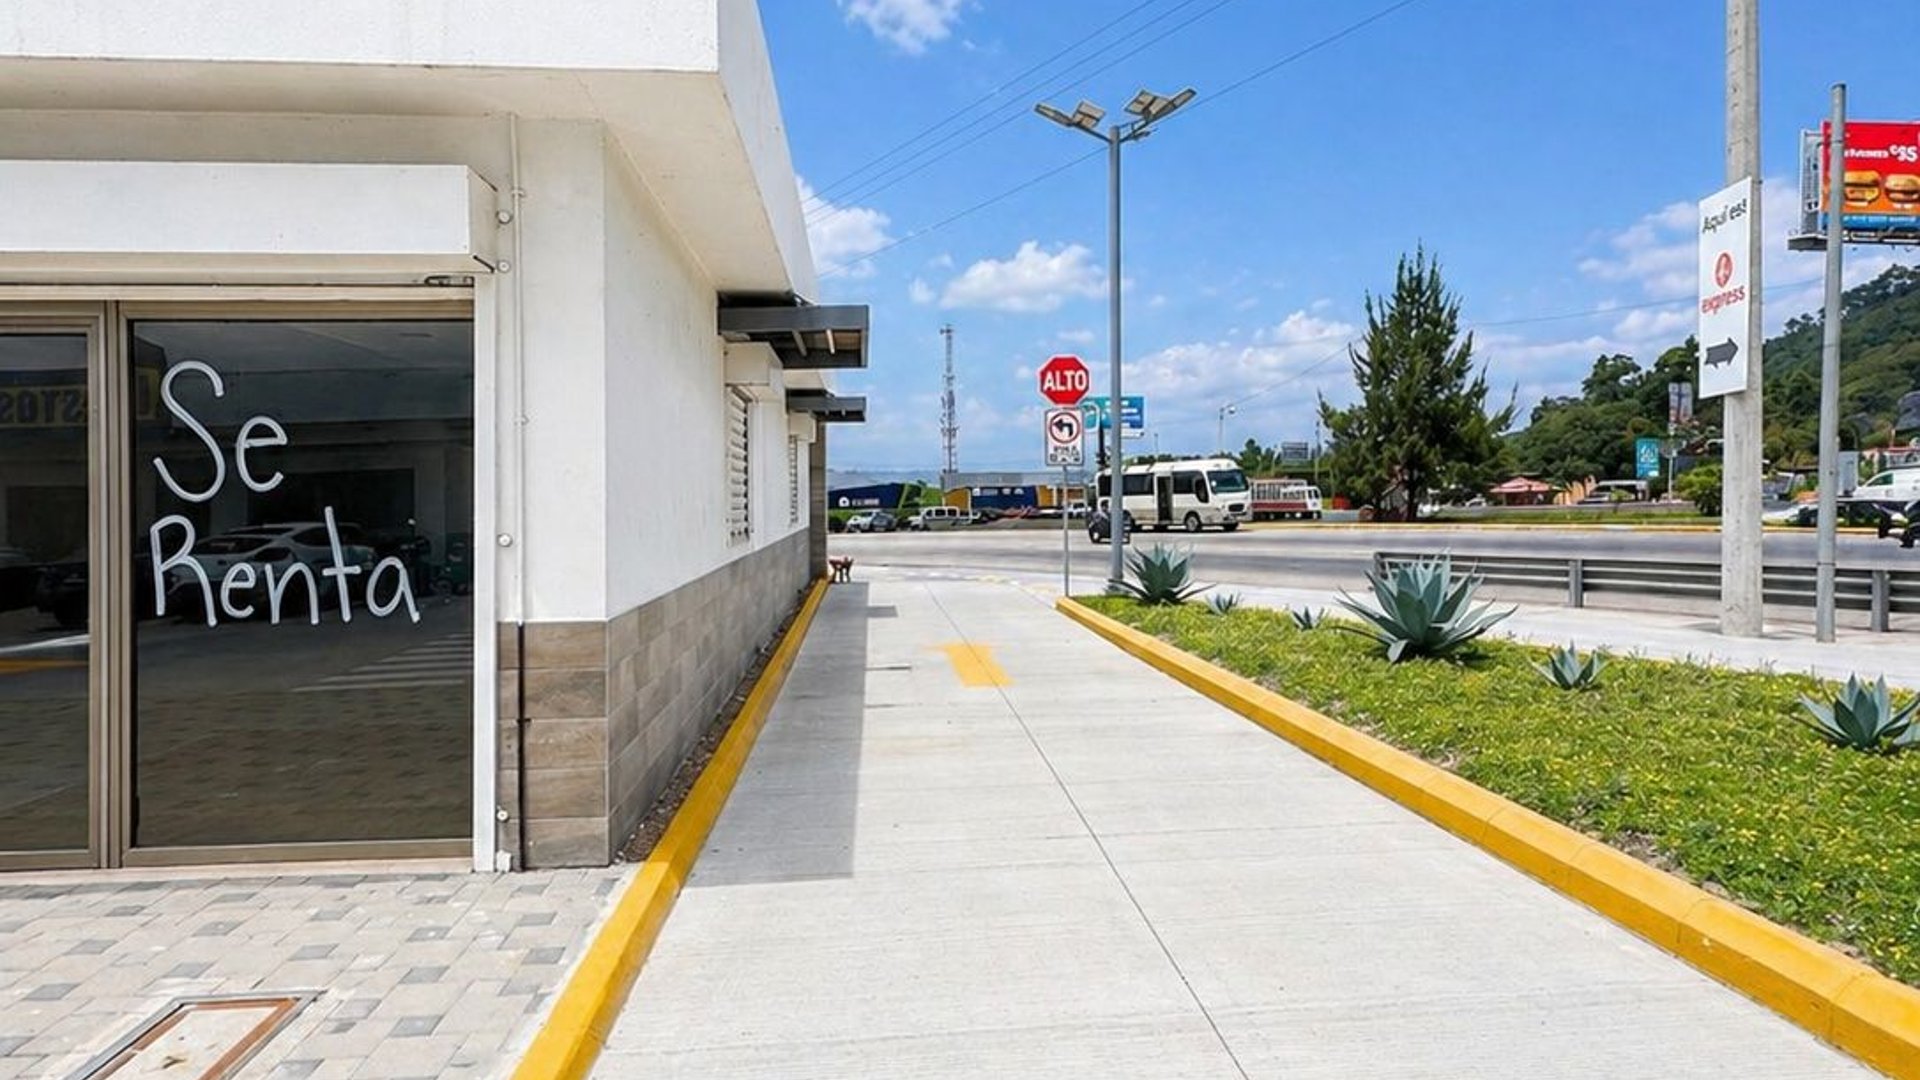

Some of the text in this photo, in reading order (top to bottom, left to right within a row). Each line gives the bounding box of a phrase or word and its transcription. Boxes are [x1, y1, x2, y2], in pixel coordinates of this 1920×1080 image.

[1701, 285, 1746, 315] express
[1043, 369, 1087, 391] ALTO
[153, 360, 288, 502] Se
[150, 506, 421, 626] Renta
